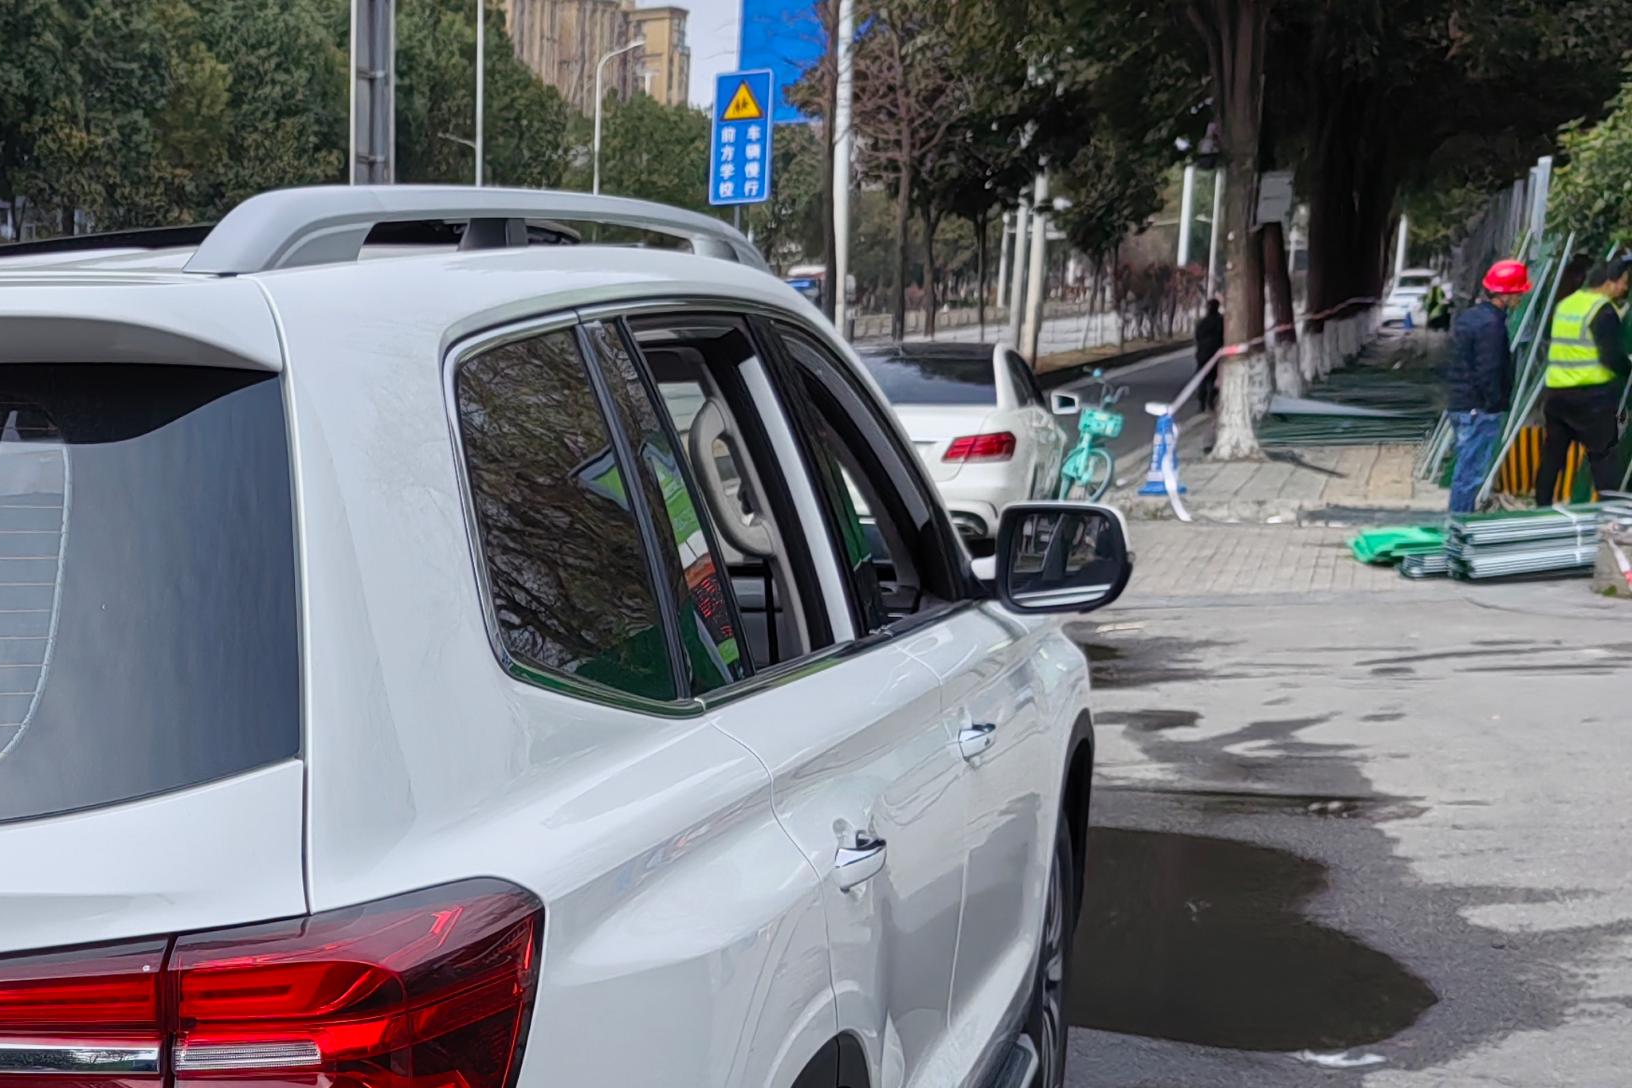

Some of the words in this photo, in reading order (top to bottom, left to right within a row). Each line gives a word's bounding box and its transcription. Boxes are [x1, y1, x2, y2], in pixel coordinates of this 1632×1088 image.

[719, 126, 737, 198] 前方学校
[744, 124, 762, 197] 车辆慢行
